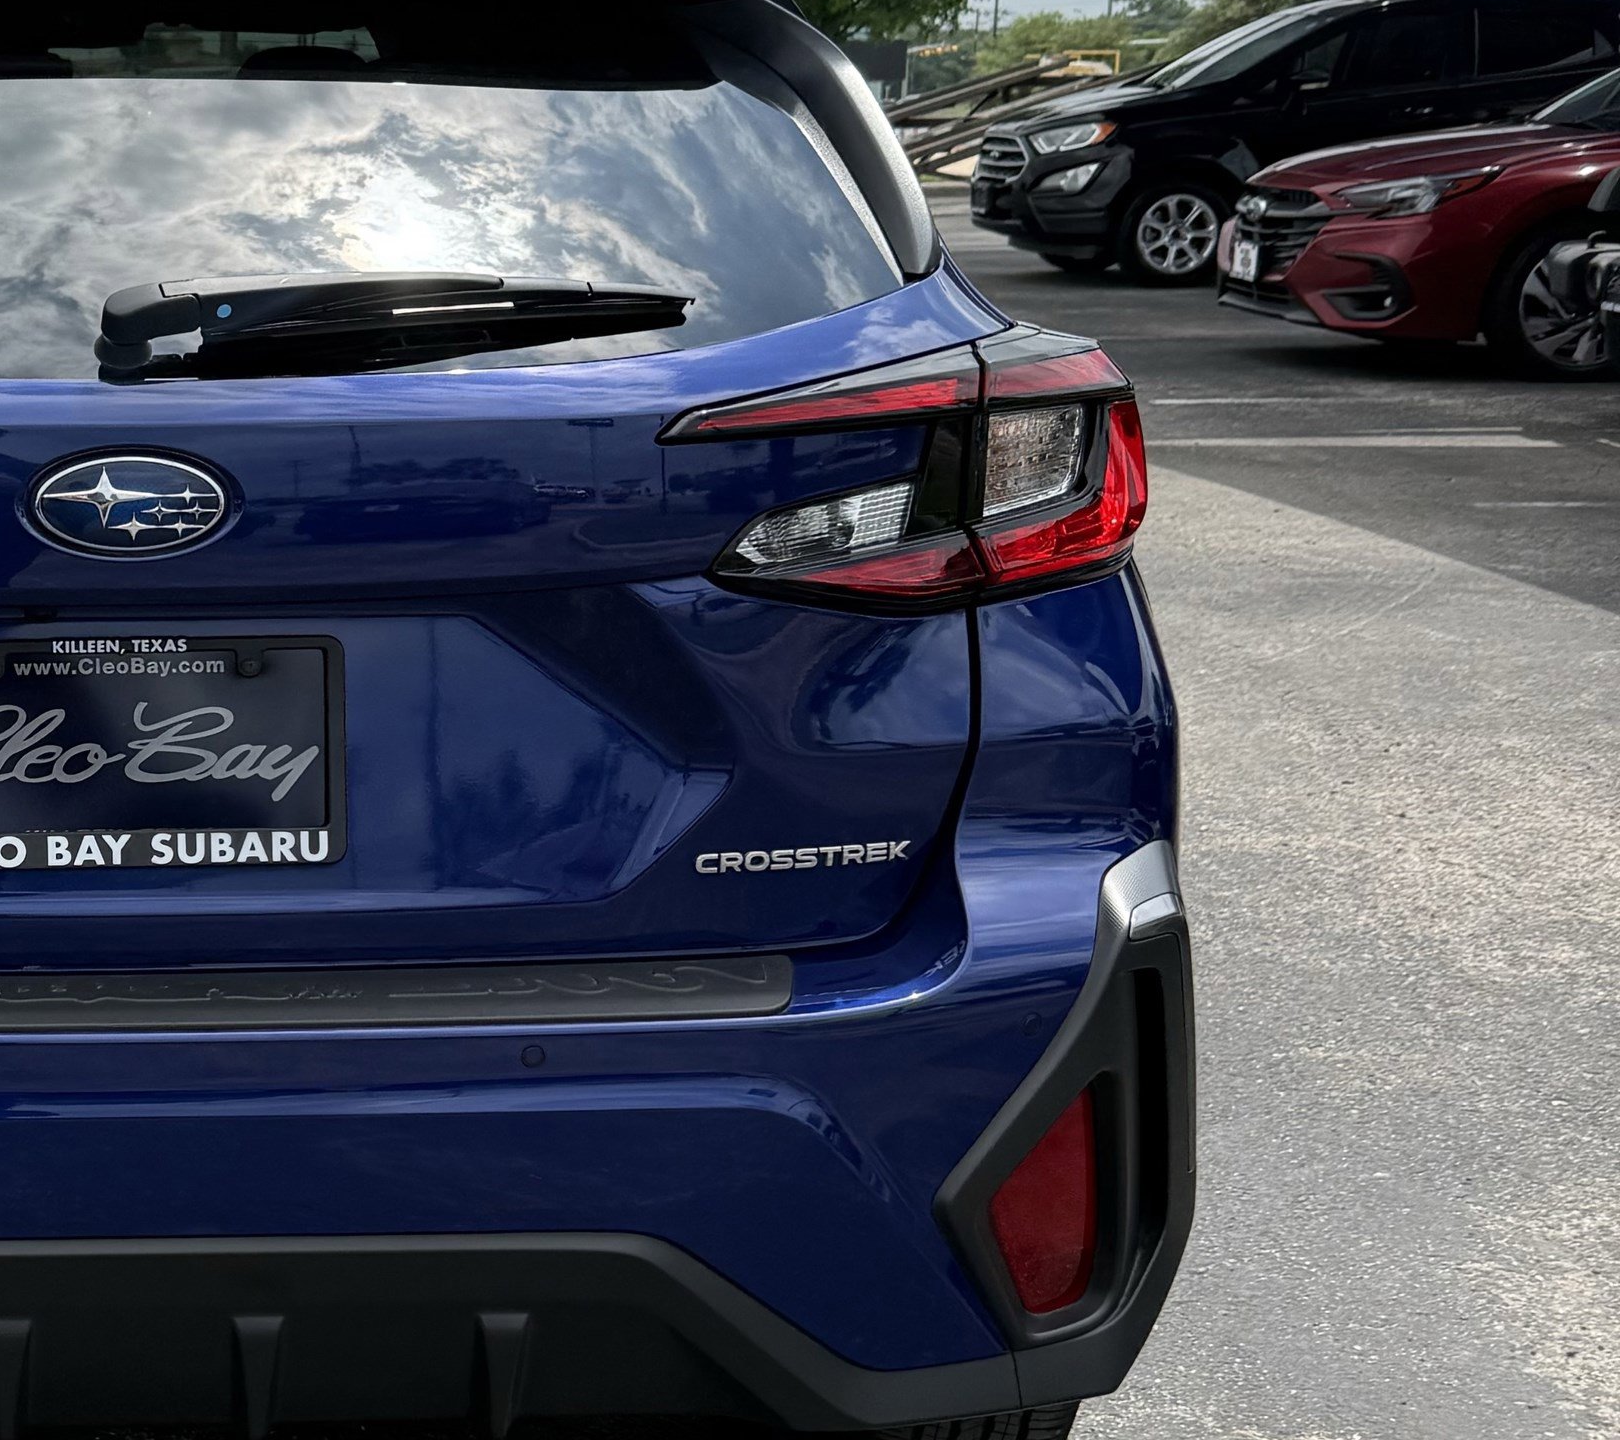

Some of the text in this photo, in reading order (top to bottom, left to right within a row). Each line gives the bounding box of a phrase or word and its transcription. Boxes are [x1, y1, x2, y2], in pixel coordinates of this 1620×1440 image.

[52, 639, 187, 654] KILLEEN, TEXAS
[14, 657, 225, 677] www.CleoBay.com
[124, 701, 320, 802] Bay
[48, 834, 131, 867] BAY
[151, 830, 329, 865] SUBARU
[695, 840, 911, 874] CROSSTREK
